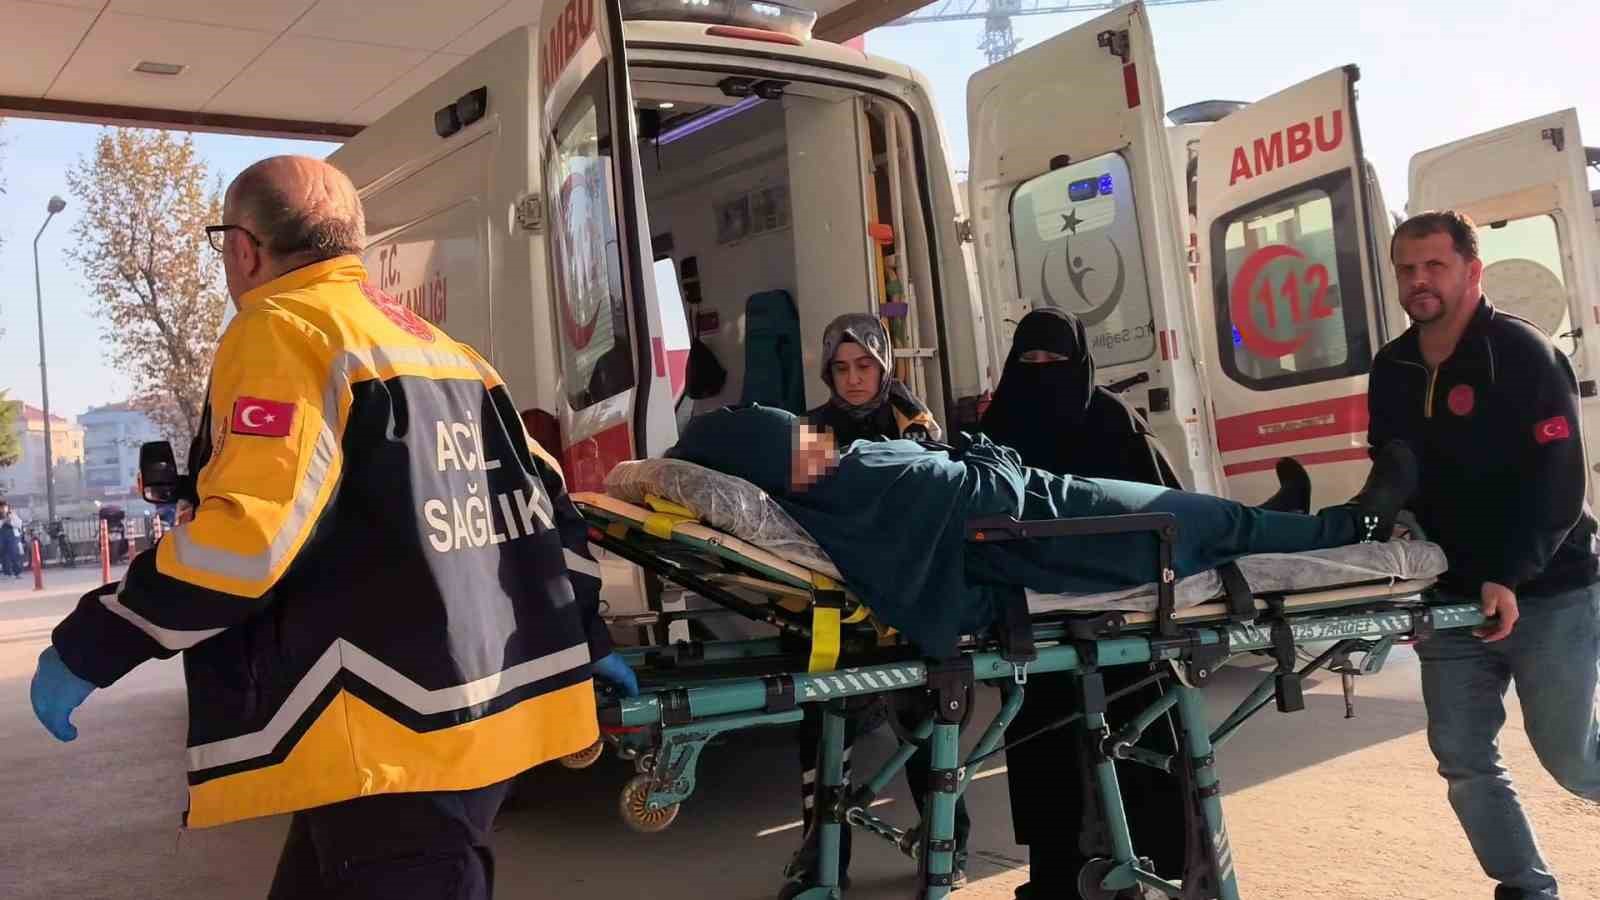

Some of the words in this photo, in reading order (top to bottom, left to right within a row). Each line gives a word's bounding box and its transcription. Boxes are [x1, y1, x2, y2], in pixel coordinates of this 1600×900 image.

[1229, 109, 1343, 187] AMBU
[1257, 263, 1335, 328] 112
[435, 410, 502, 472] ACİL
[424, 482, 556, 553] SAĞLIK
